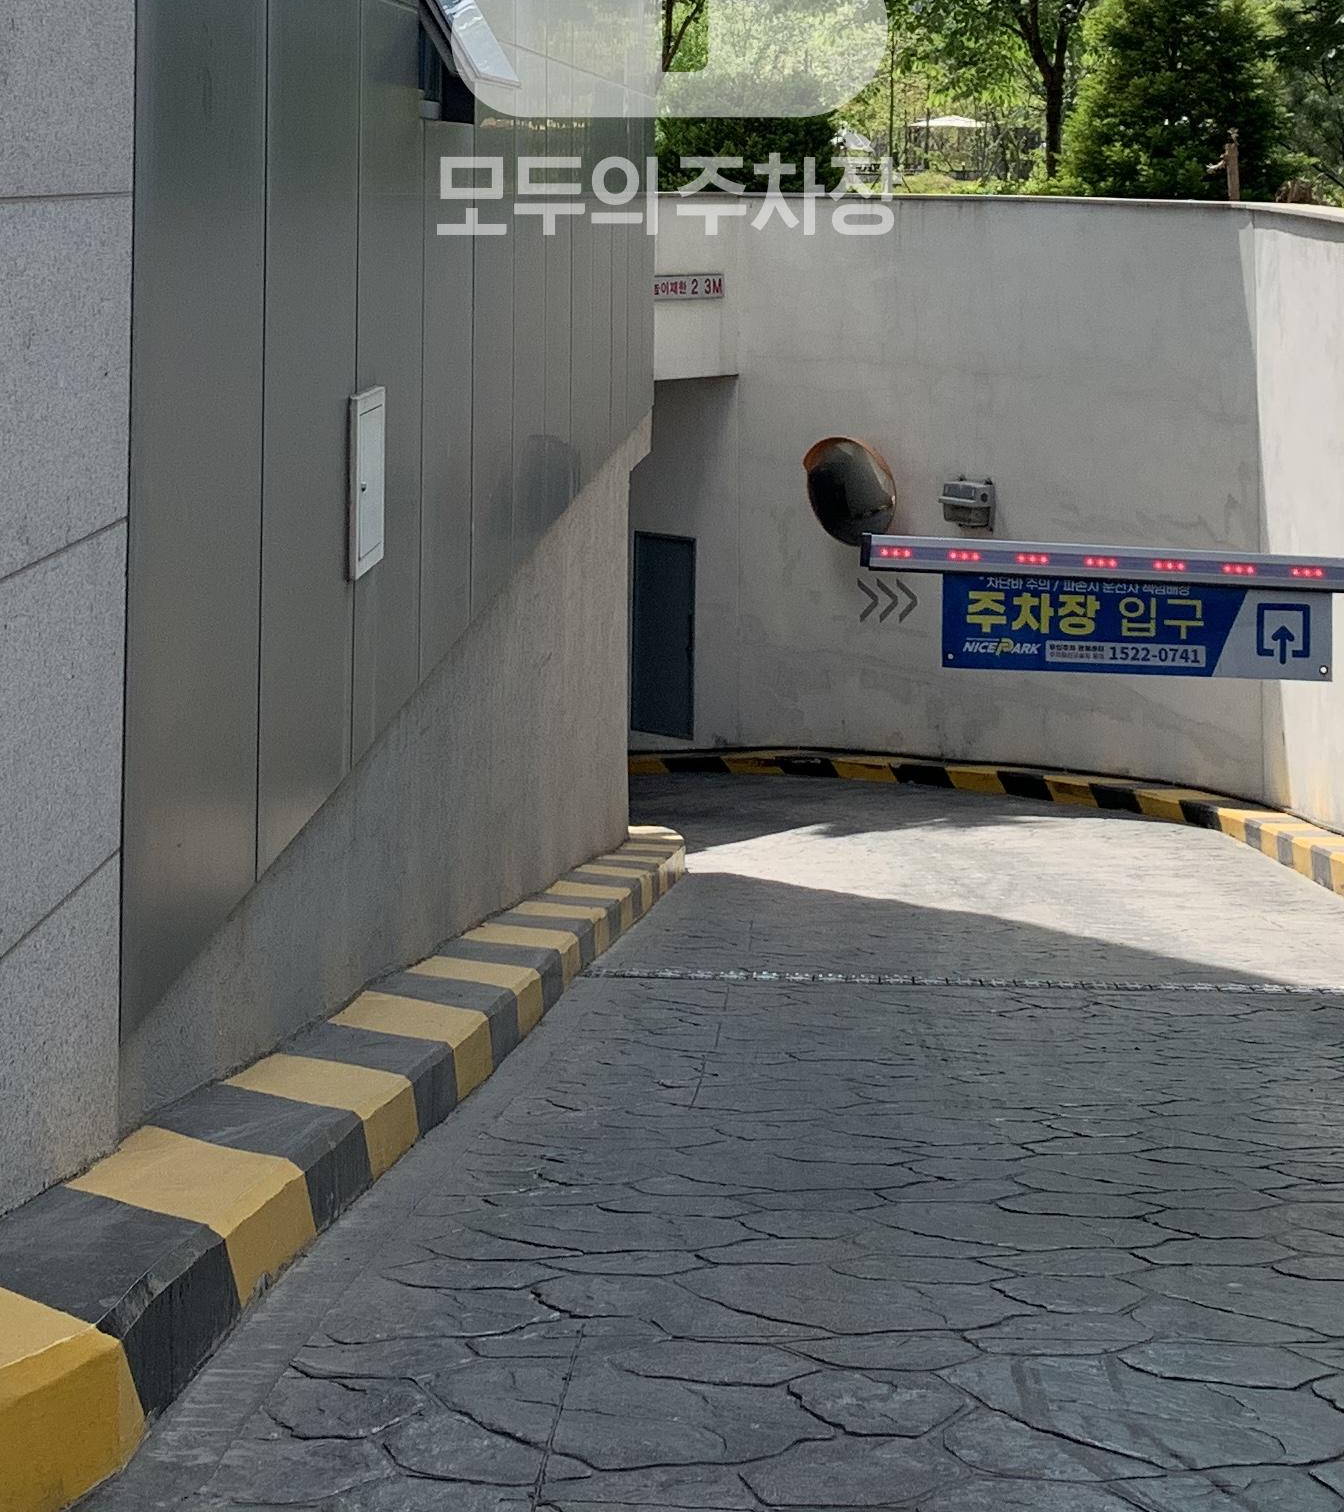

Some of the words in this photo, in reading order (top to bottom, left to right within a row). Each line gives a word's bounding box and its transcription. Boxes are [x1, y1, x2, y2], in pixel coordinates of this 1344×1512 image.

[1026, 579, 1051, 592] 주의
[966, 591, 1101, 636] 주차장
[1118, 596, 1205, 639] 입구
[963, 638, 1042, 656] NICEPARK
[1109, 646, 1201, 664] 1522-0741
